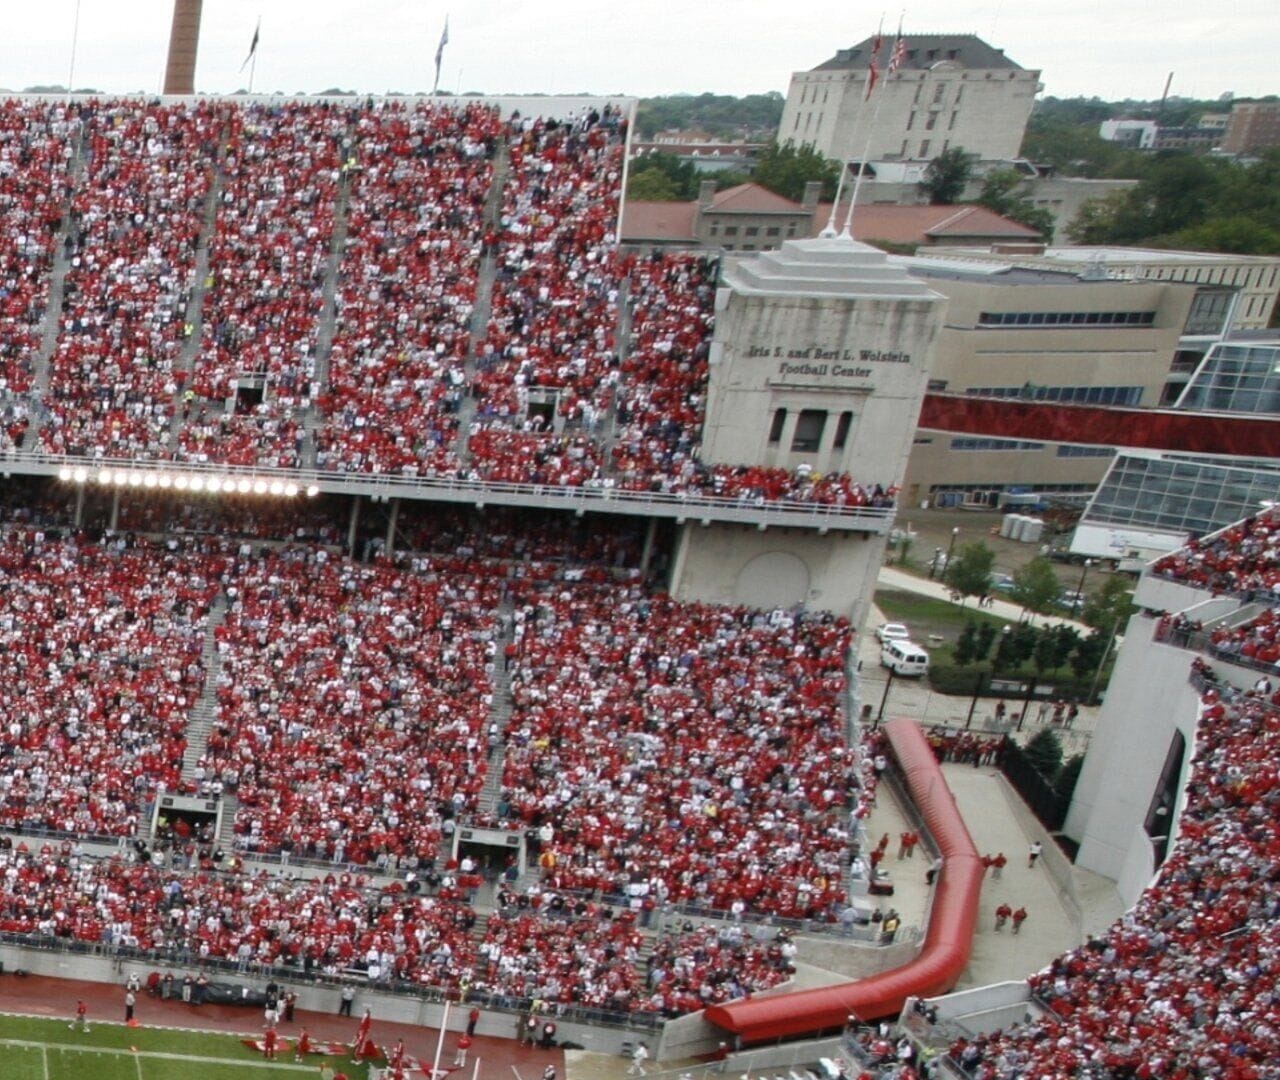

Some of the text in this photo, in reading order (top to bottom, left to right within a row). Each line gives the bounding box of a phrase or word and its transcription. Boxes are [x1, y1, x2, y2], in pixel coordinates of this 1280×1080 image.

[787, 347, 810, 359] and
[814, 348, 840, 361] Bert
[859, 349, 911, 363] Wolstein
[779, 363, 873, 378] Football Center
